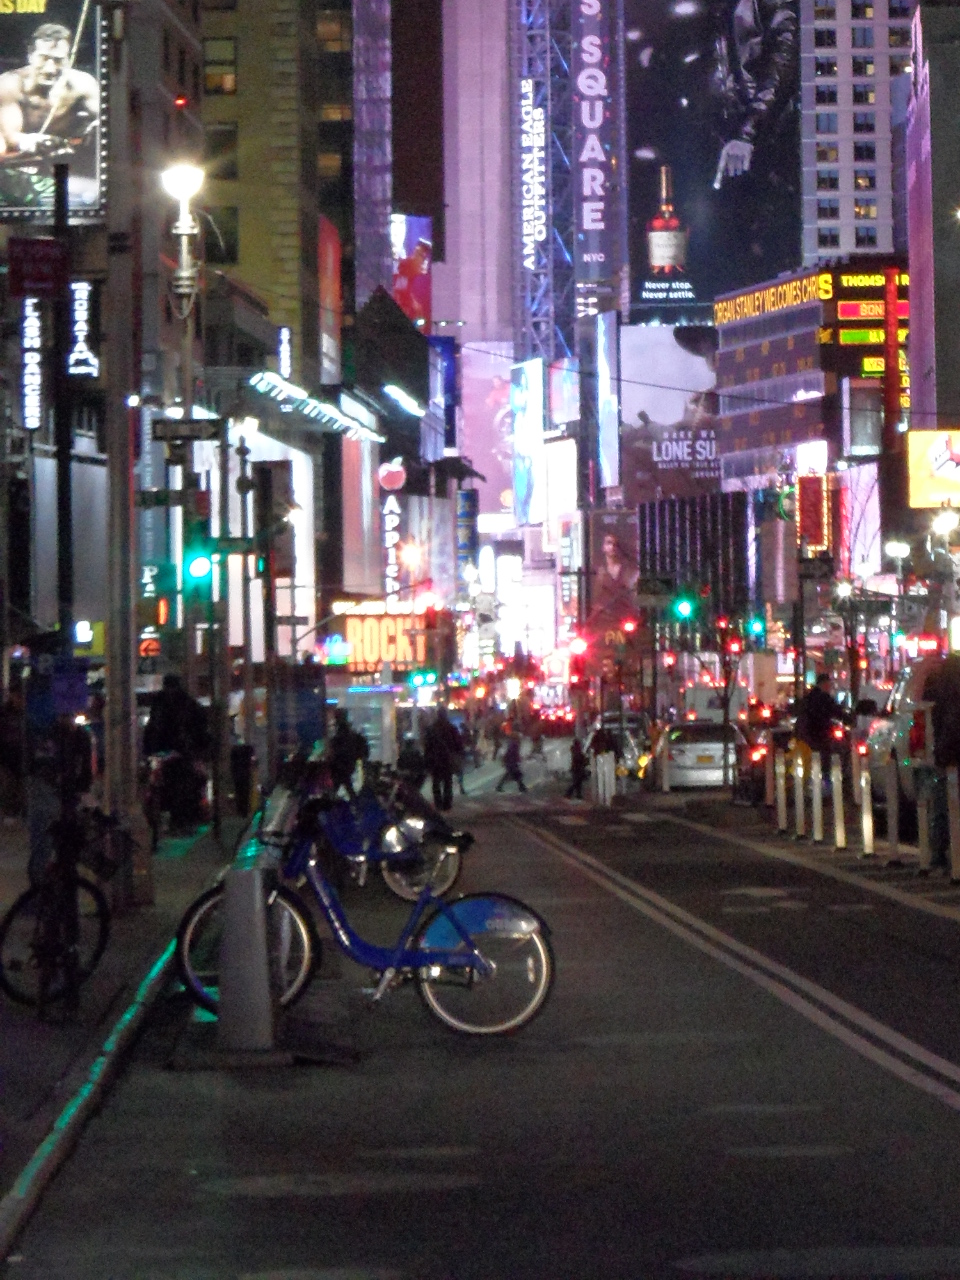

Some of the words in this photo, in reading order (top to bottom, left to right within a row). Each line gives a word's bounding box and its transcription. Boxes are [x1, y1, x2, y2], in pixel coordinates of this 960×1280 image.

[521, 78, 533, 147] EAGLE
[576, 35, 608, 231] SQUARE
[533, 107, 547, 242] OUTFITTERS
[522, 153, 536, 270] AMERICAN
[583, 253, 605, 262] NYC
[642, 290, 667, 298] Never
[645, 281, 670, 289] Never
[736, 291, 764, 320] STANLEY
[764, 281, 801, 314] WELCOMES
[652, 440, 693, 461] LONE
